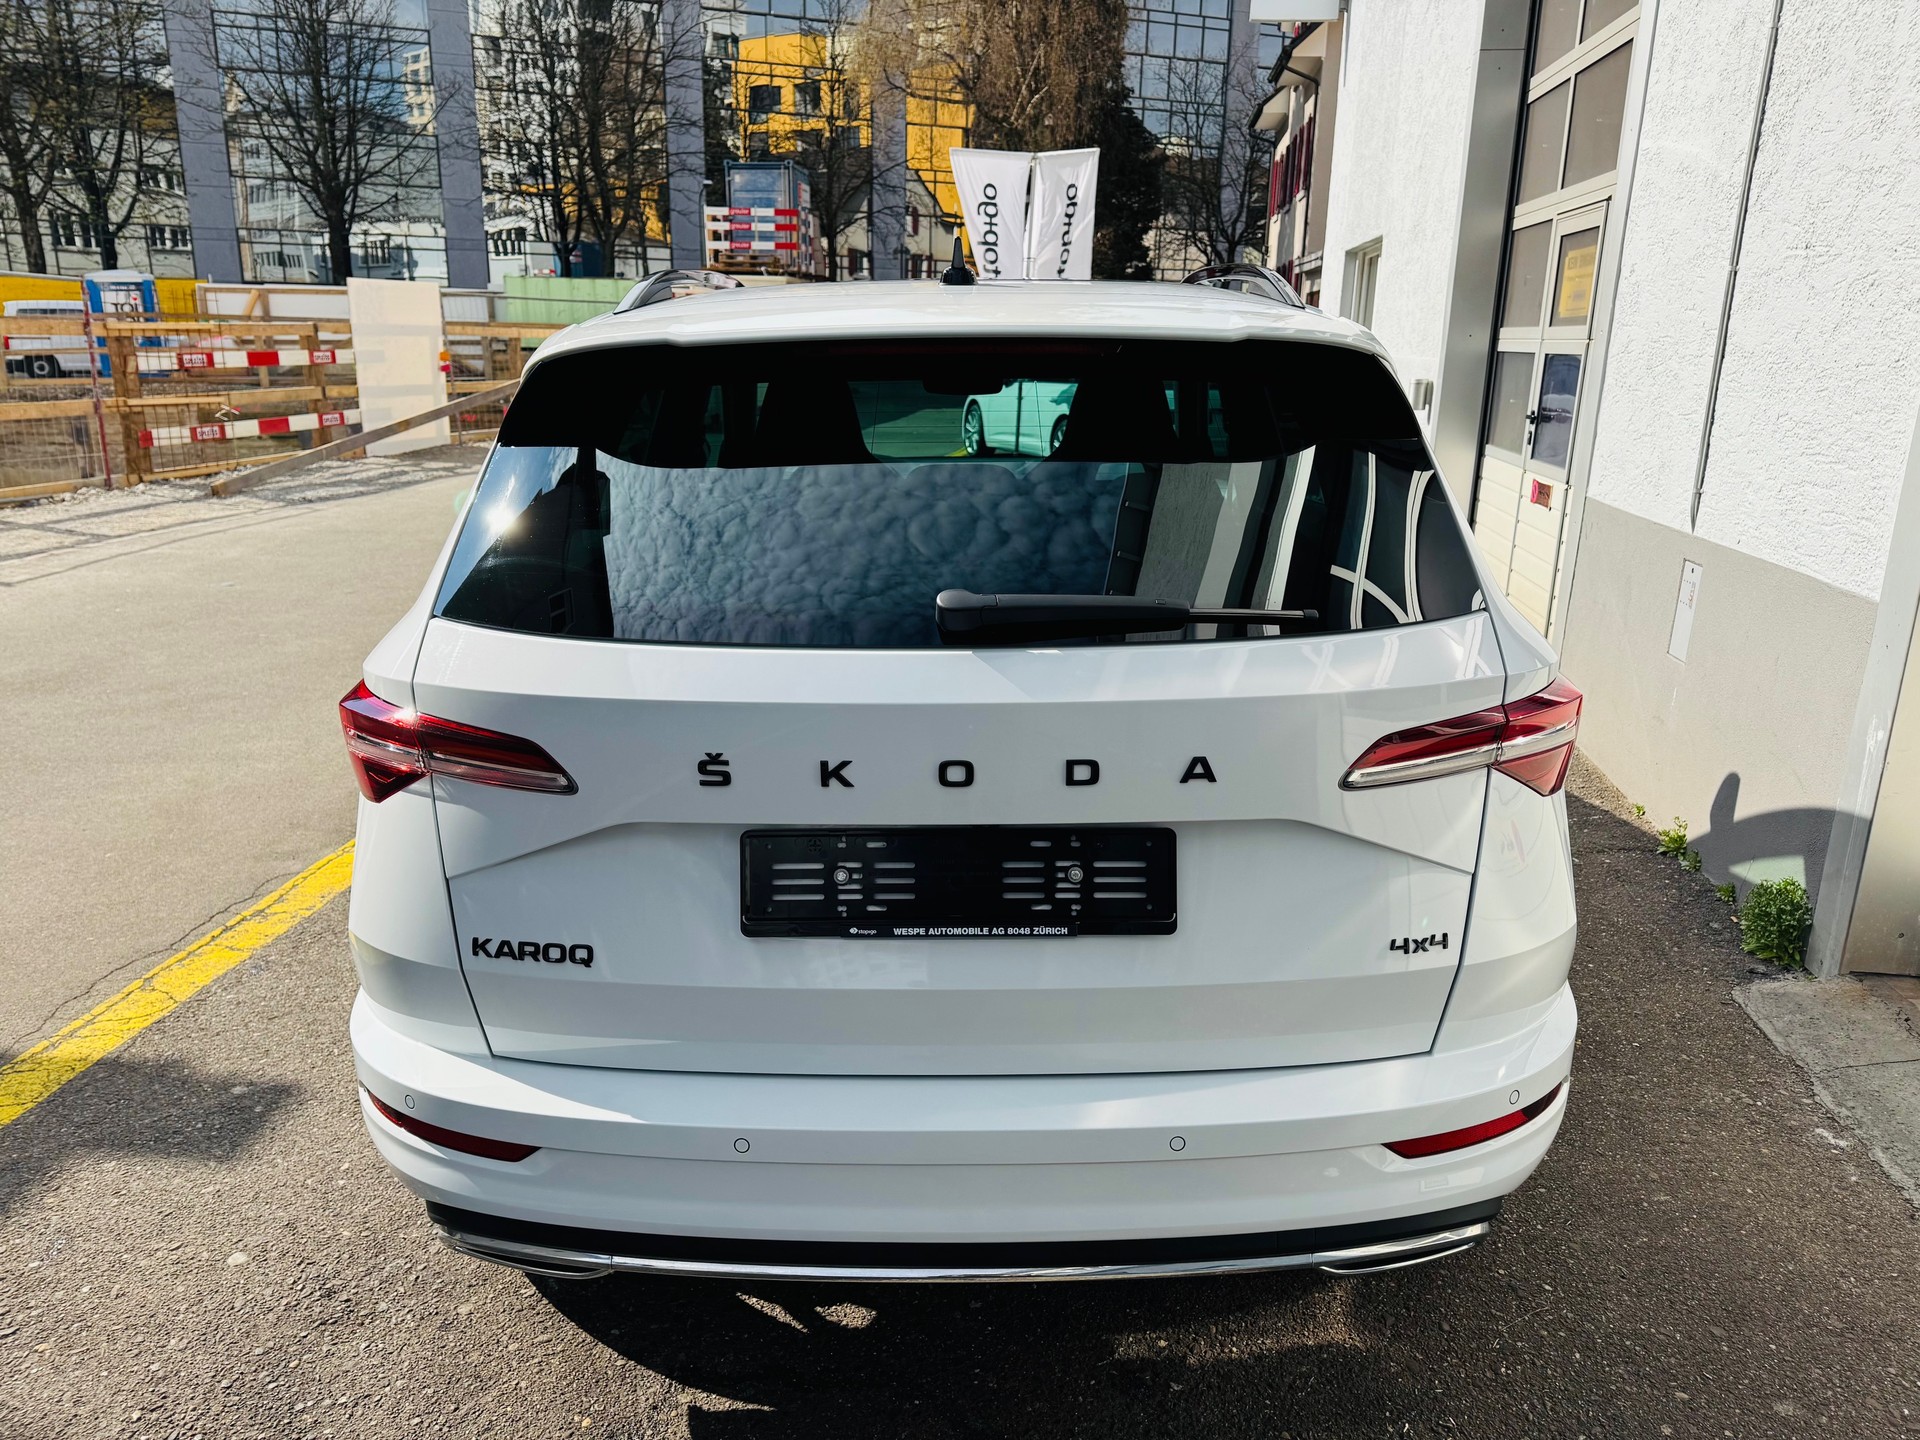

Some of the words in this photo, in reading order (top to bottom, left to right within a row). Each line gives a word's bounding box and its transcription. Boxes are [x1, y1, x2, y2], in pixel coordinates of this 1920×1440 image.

[1057, 183, 1078, 279] top+go
[697, 752, 1218, 788] ŠKODA
[893, 927, 926, 936] WESPE
[928, 927, 989, 936] AUTOMOBILE
[991, 927, 1005, 936] AG
[1007, 927, 1031, 936] 8048
[1033, 925, 1068, 936] ZÜRICH
[471, 936, 595, 969] KAROQ
